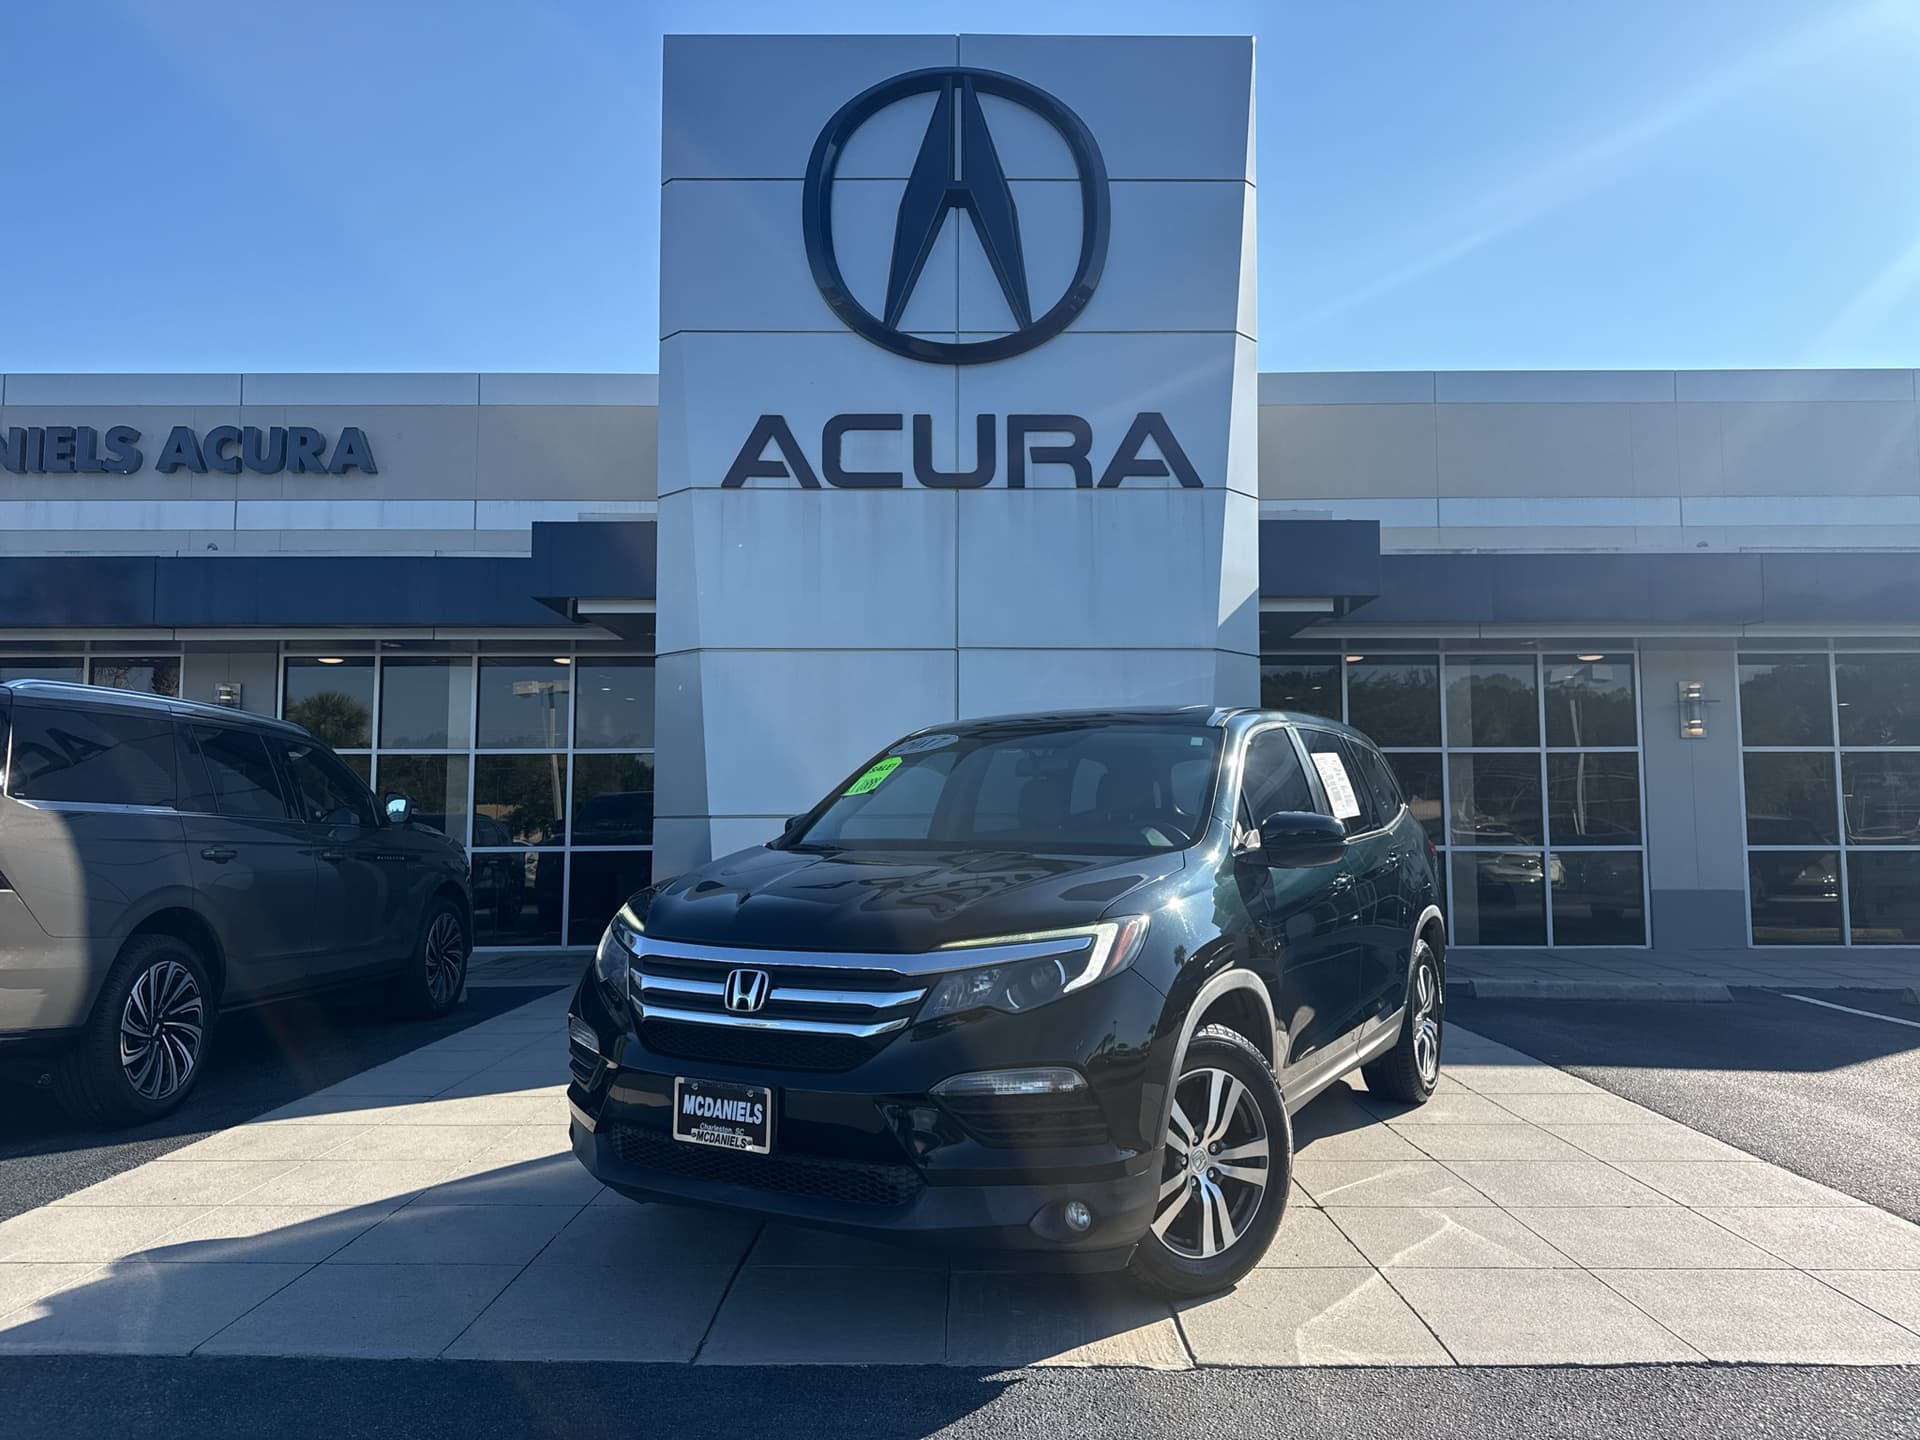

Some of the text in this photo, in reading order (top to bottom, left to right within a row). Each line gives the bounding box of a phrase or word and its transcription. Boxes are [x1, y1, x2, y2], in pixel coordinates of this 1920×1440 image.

[155, 425, 378, 475] ACURA
[721, 411, 1204, 489] ACURA
[682, 1094, 763, 1125] MCDANIELS
[696, 1131, 747, 1148] MCDANIELS
